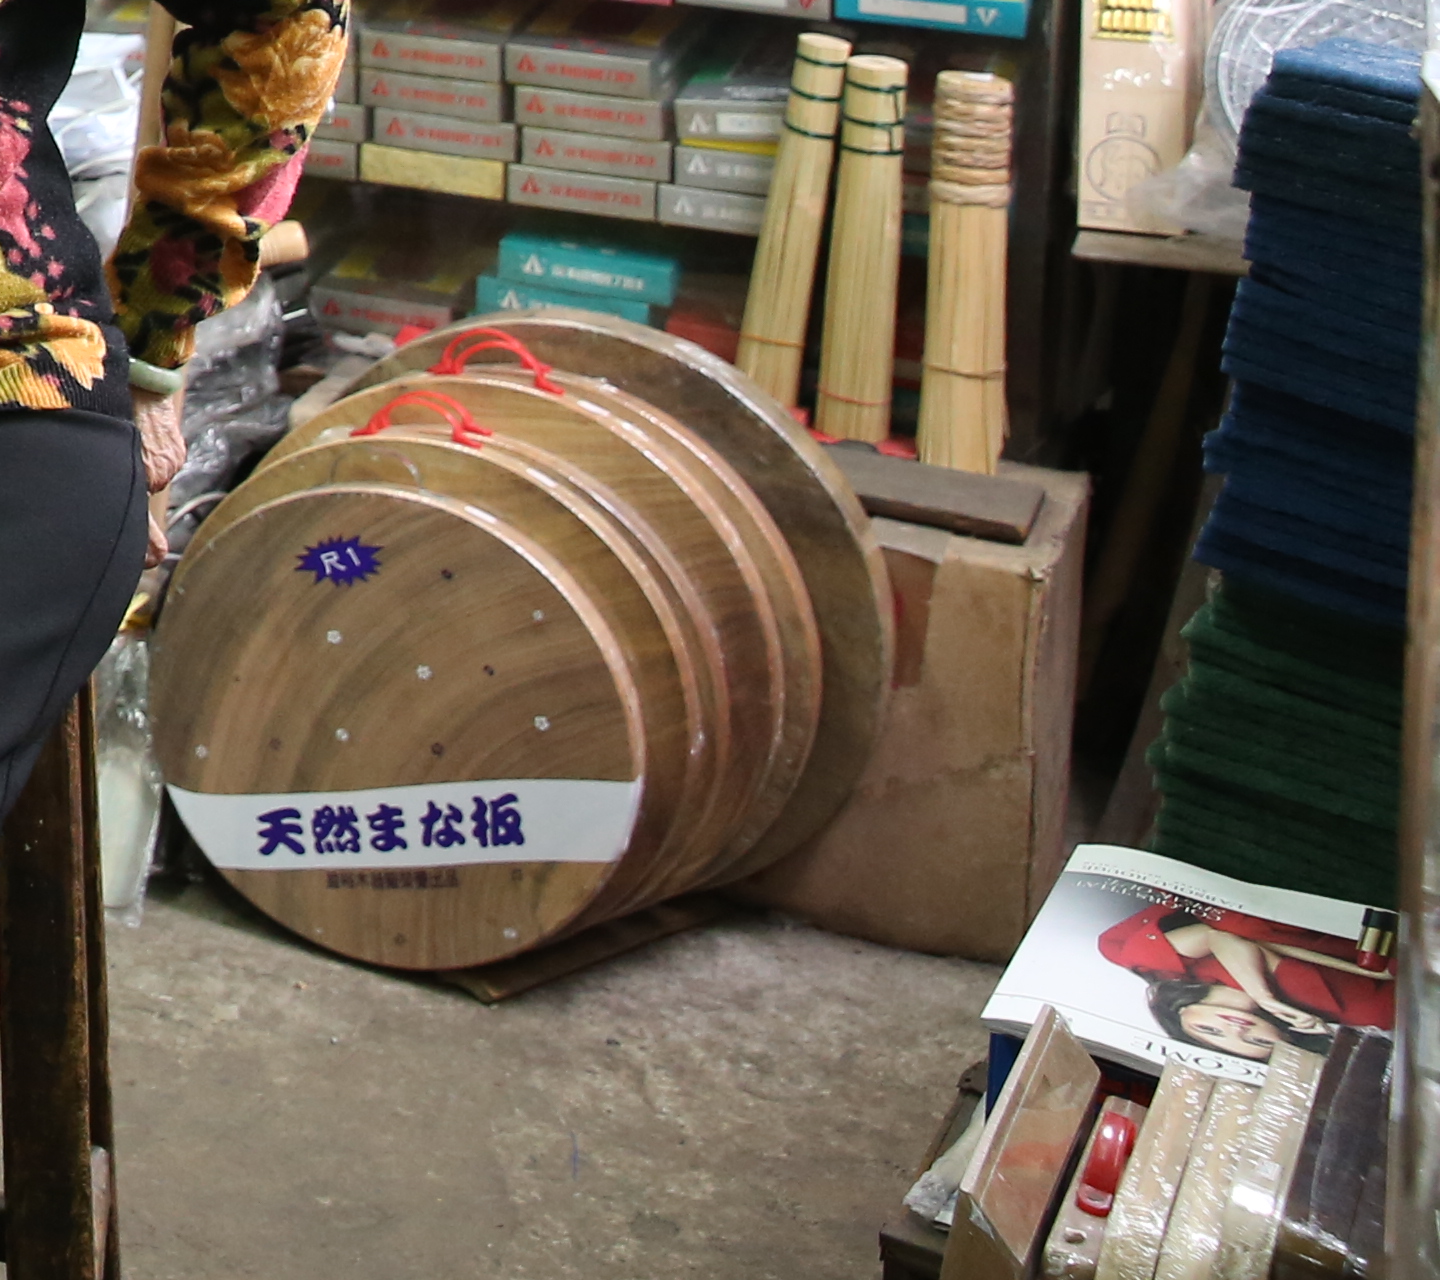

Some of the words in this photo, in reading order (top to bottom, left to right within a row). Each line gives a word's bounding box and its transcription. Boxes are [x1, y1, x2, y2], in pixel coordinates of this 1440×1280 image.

[318, 547, 361, 575] R1
[256, 793, 524, 856] 天然まな板
